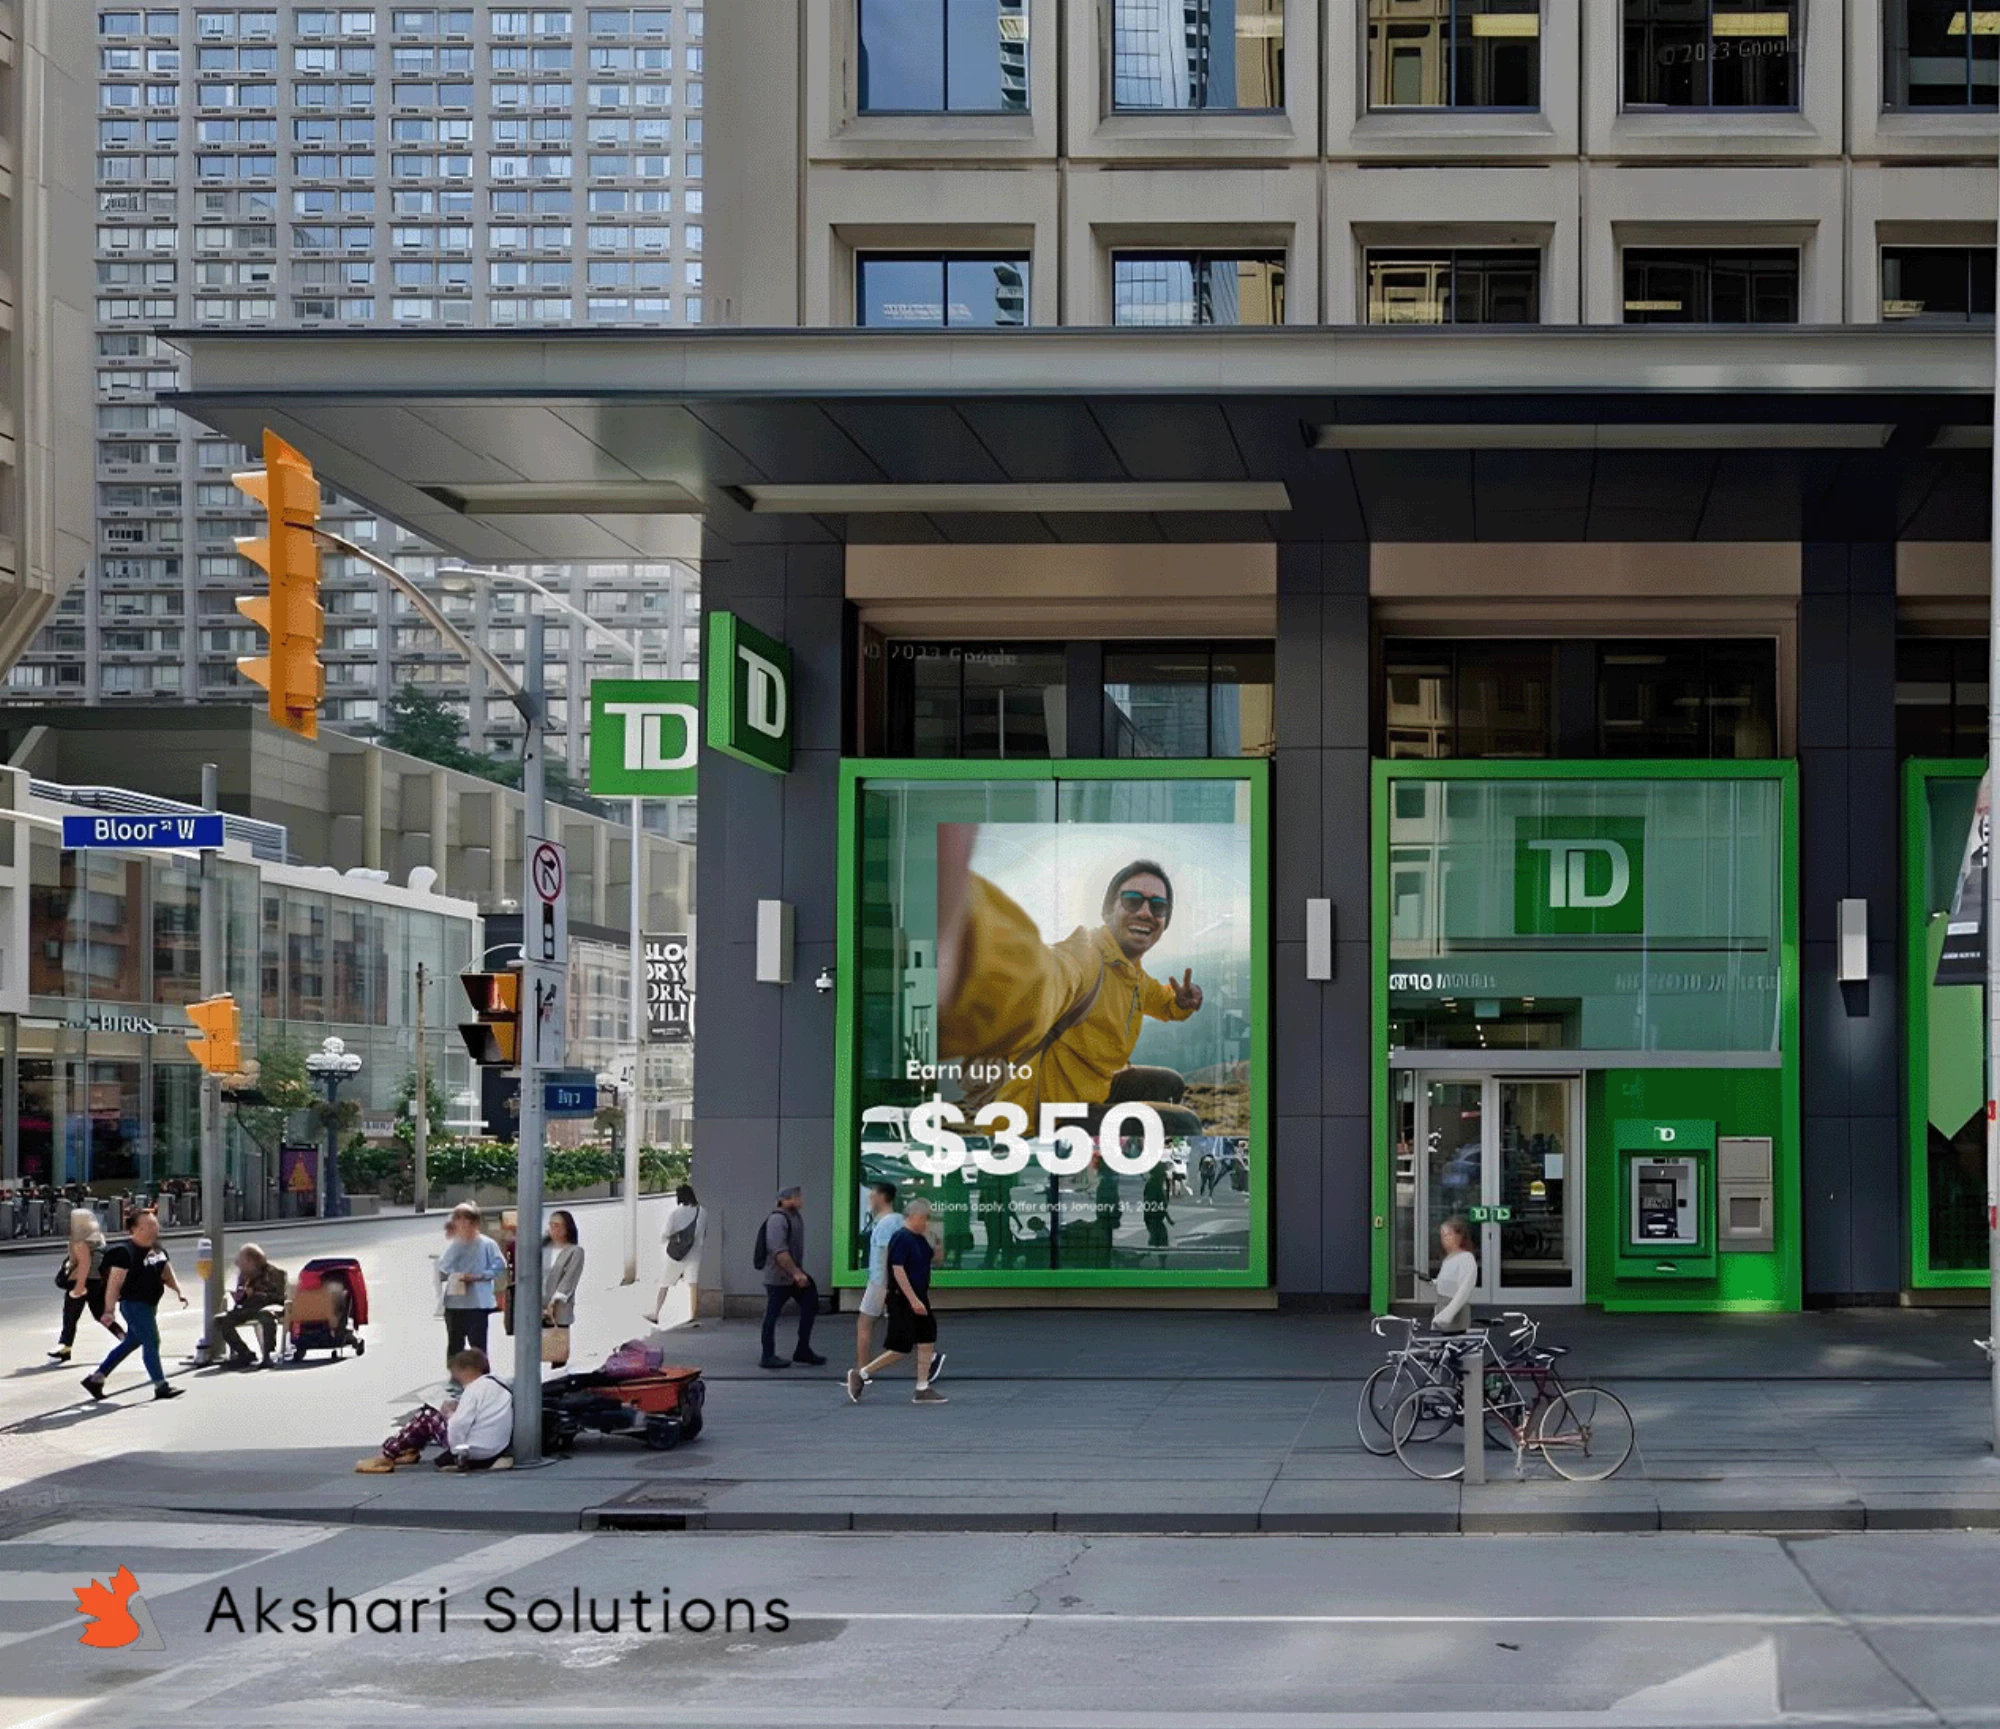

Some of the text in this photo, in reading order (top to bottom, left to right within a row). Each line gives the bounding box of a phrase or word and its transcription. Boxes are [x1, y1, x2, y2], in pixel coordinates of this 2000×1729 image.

[738, 643, 787, 739] TD
[604, 702, 699, 770] TD
[95, 819, 158, 841] Bloor
[177, 819, 195, 840] W
[1527, 838, 1631, 909] TD
[906, 1060, 1033, 1084] Earn up to
[907, 1092, 1166, 1188] $350
[1007, 1200, 1037, 1212] Offer
[1039, 1200, 1067, 1212] ends
[1070, 1200, 1117, 1214] January
